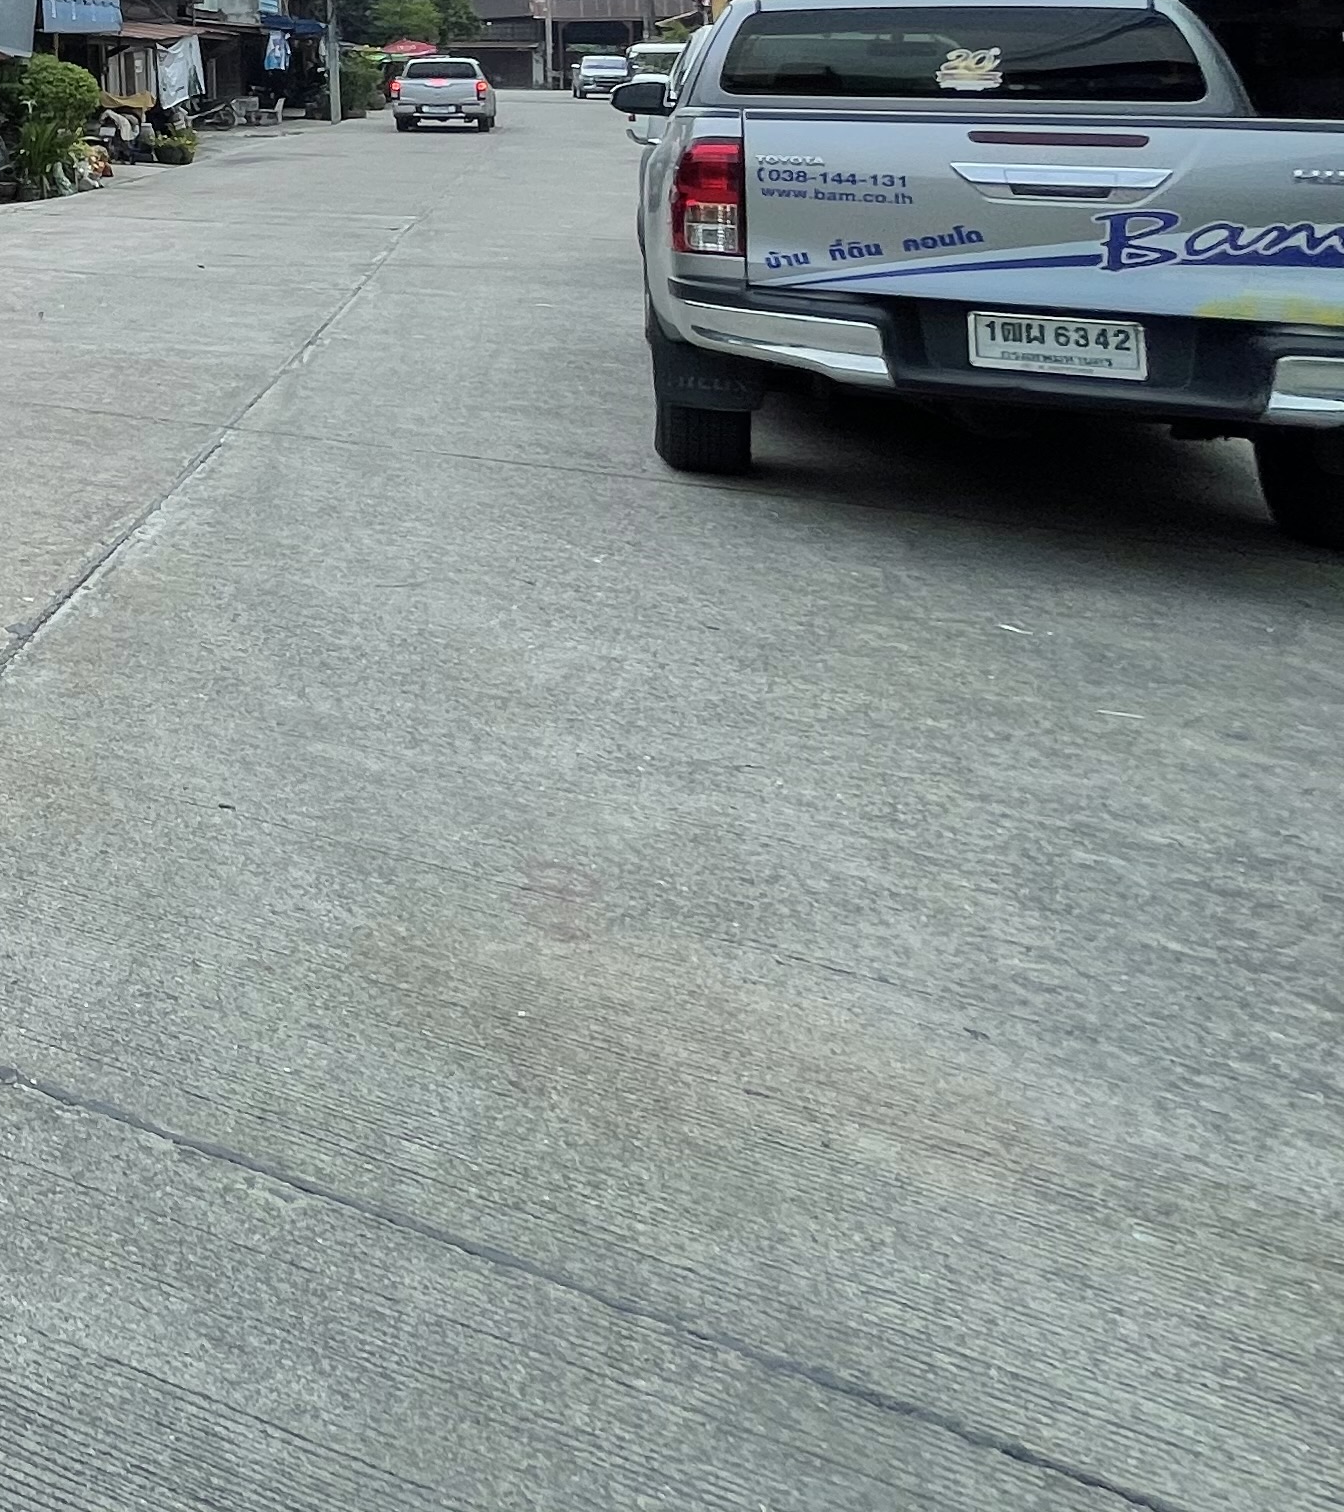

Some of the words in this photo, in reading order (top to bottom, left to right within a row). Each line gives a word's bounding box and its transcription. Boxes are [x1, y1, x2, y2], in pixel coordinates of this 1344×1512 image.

[754, 155, 825, 166] TOYOTA
[765, 251, 811, 269] บ้าน
[828, 238, 884, 262] ที่ดิน
[902, 225, 985, 253] คอนโด
[1054, 325, 1131, 352] 6342
